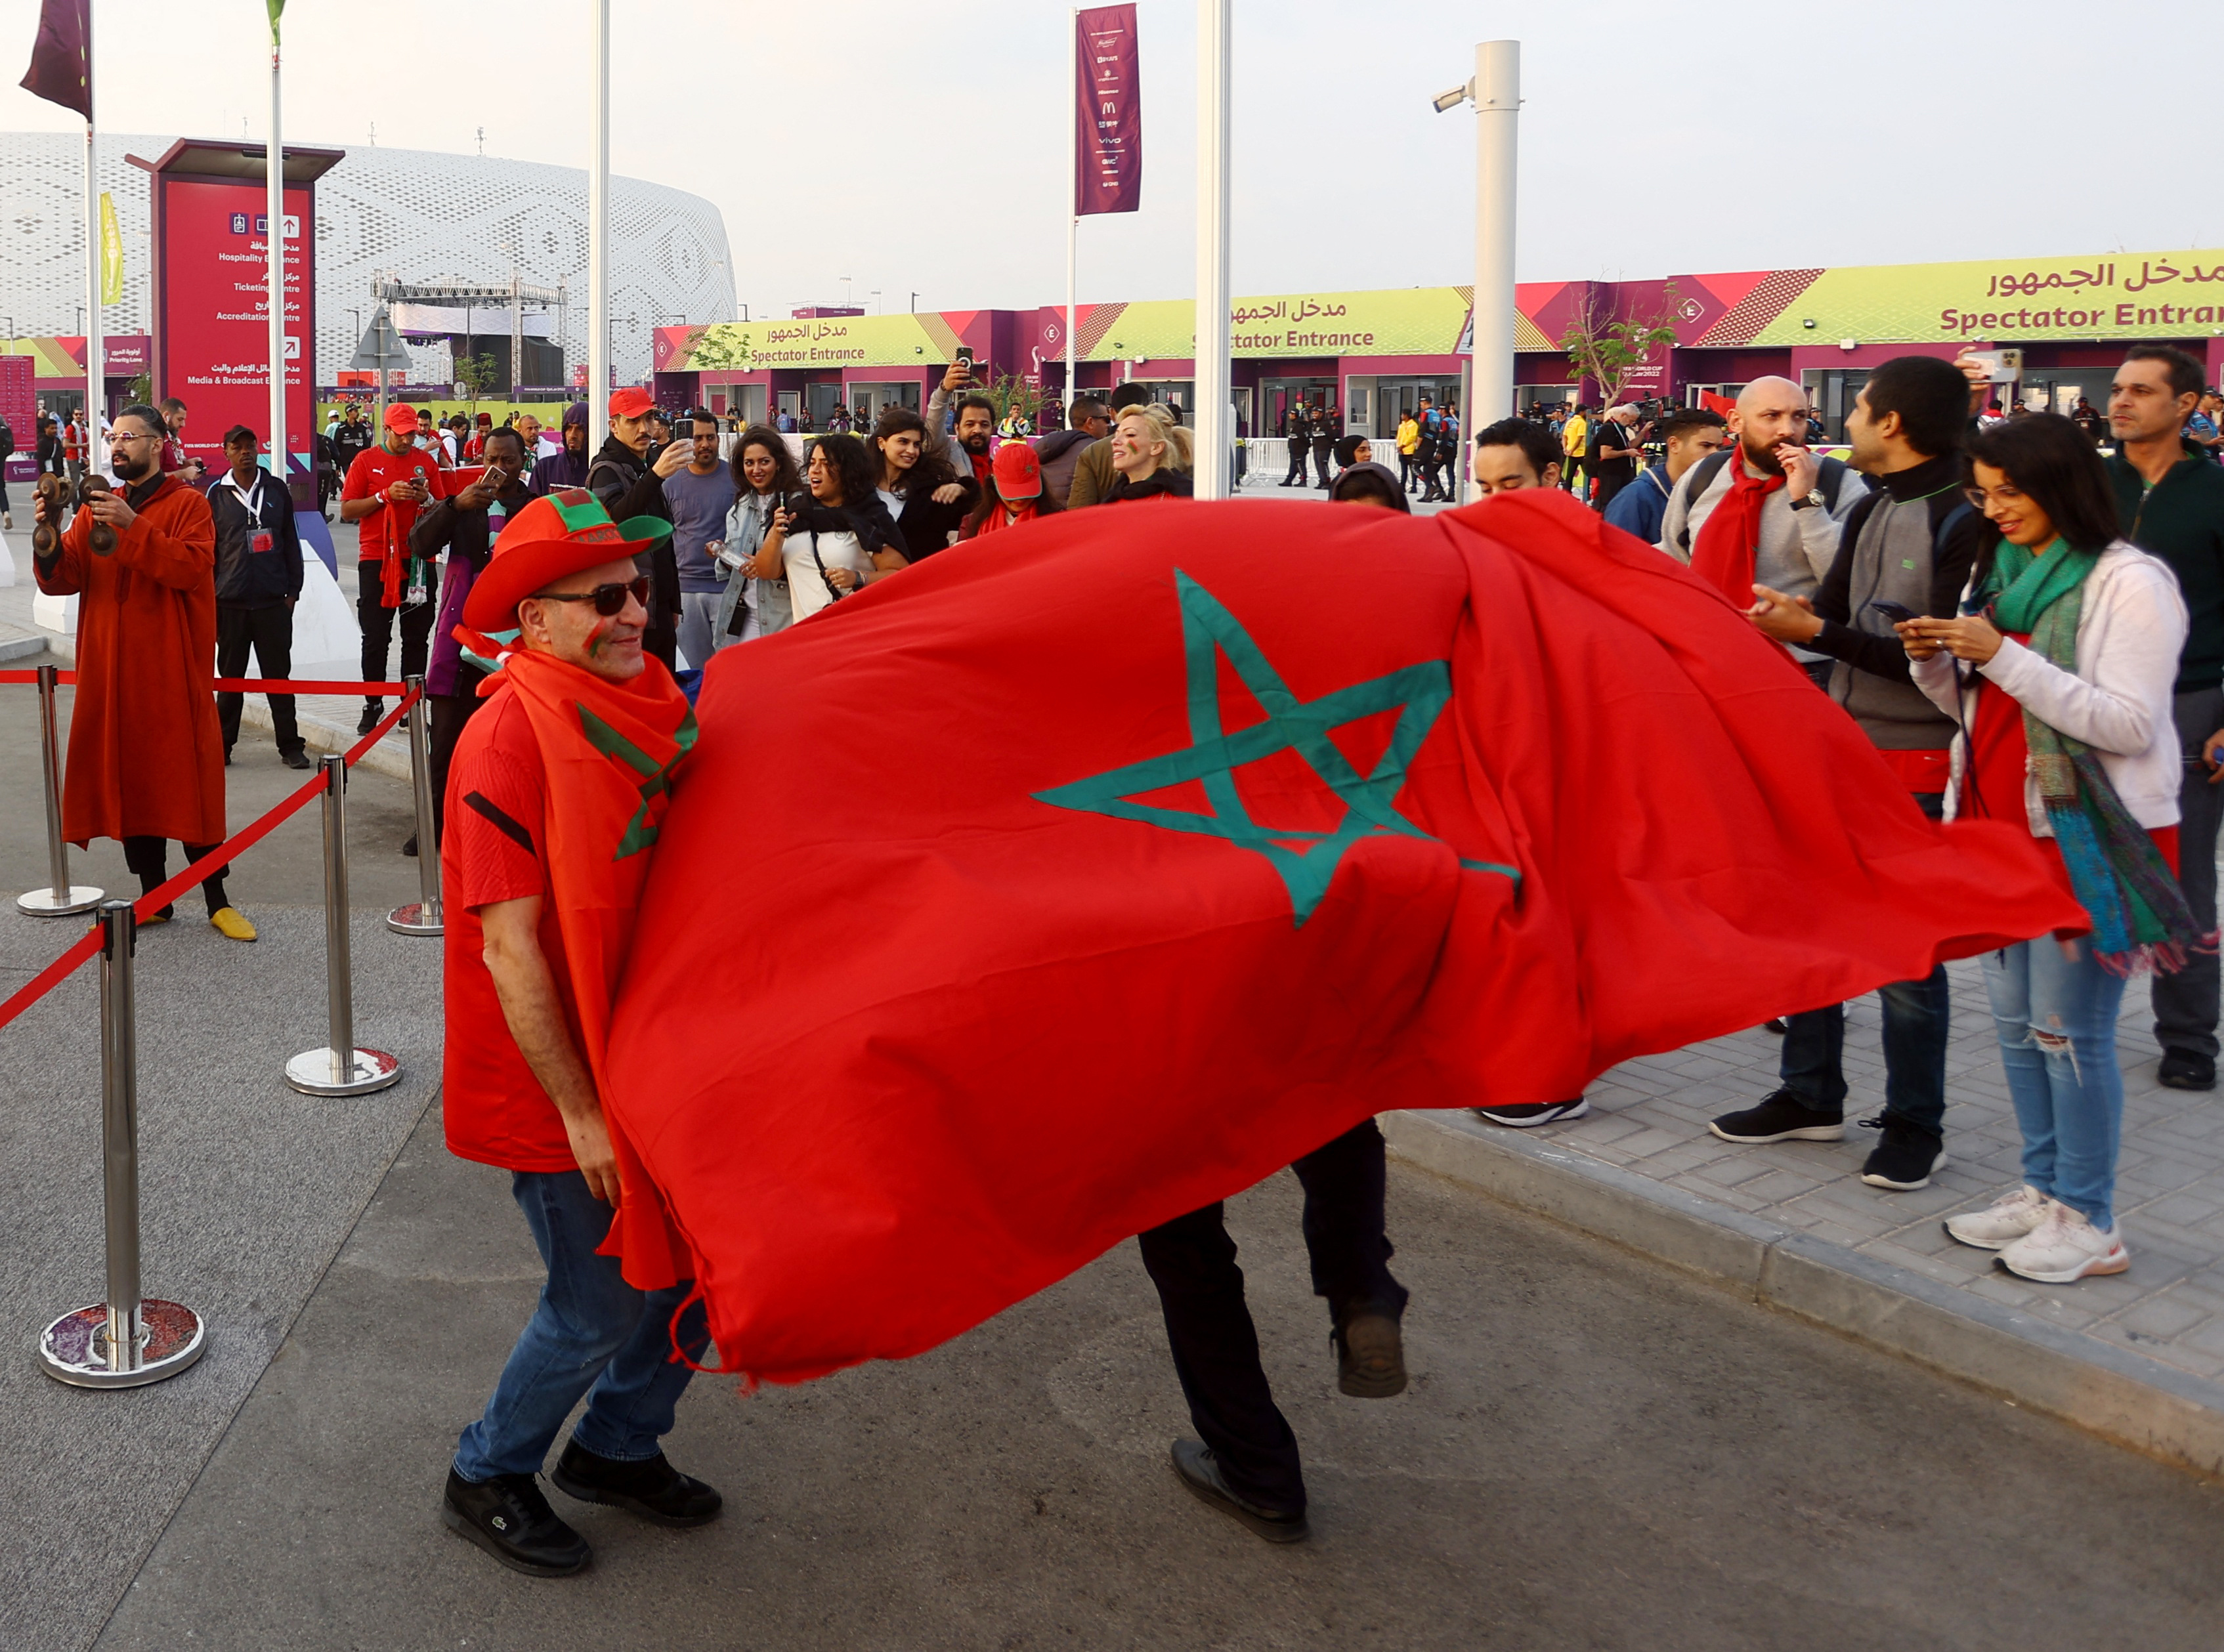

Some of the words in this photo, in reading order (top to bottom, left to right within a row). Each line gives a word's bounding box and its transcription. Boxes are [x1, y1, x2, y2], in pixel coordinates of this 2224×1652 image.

[219, 252, 263, 264] Hospitality
[1987, 263, 2115, 297] الجمهور
[1291, 298, 1347, 322] مدخل
[1686, 305, 1695, 316] E
[1940, 307, 2106, 335] Spectator
[767, 324, 811, 343] الجمهور
[813, 322, 847, 341] مدخل
[1048, 329, 1055, 338] E
[1286, 330, 1374, 347] Entrance
[751, 349, 807, 366] Spectator
[810, 347, 865, 360] Entrance
[187, 376, 213, 385] Media
